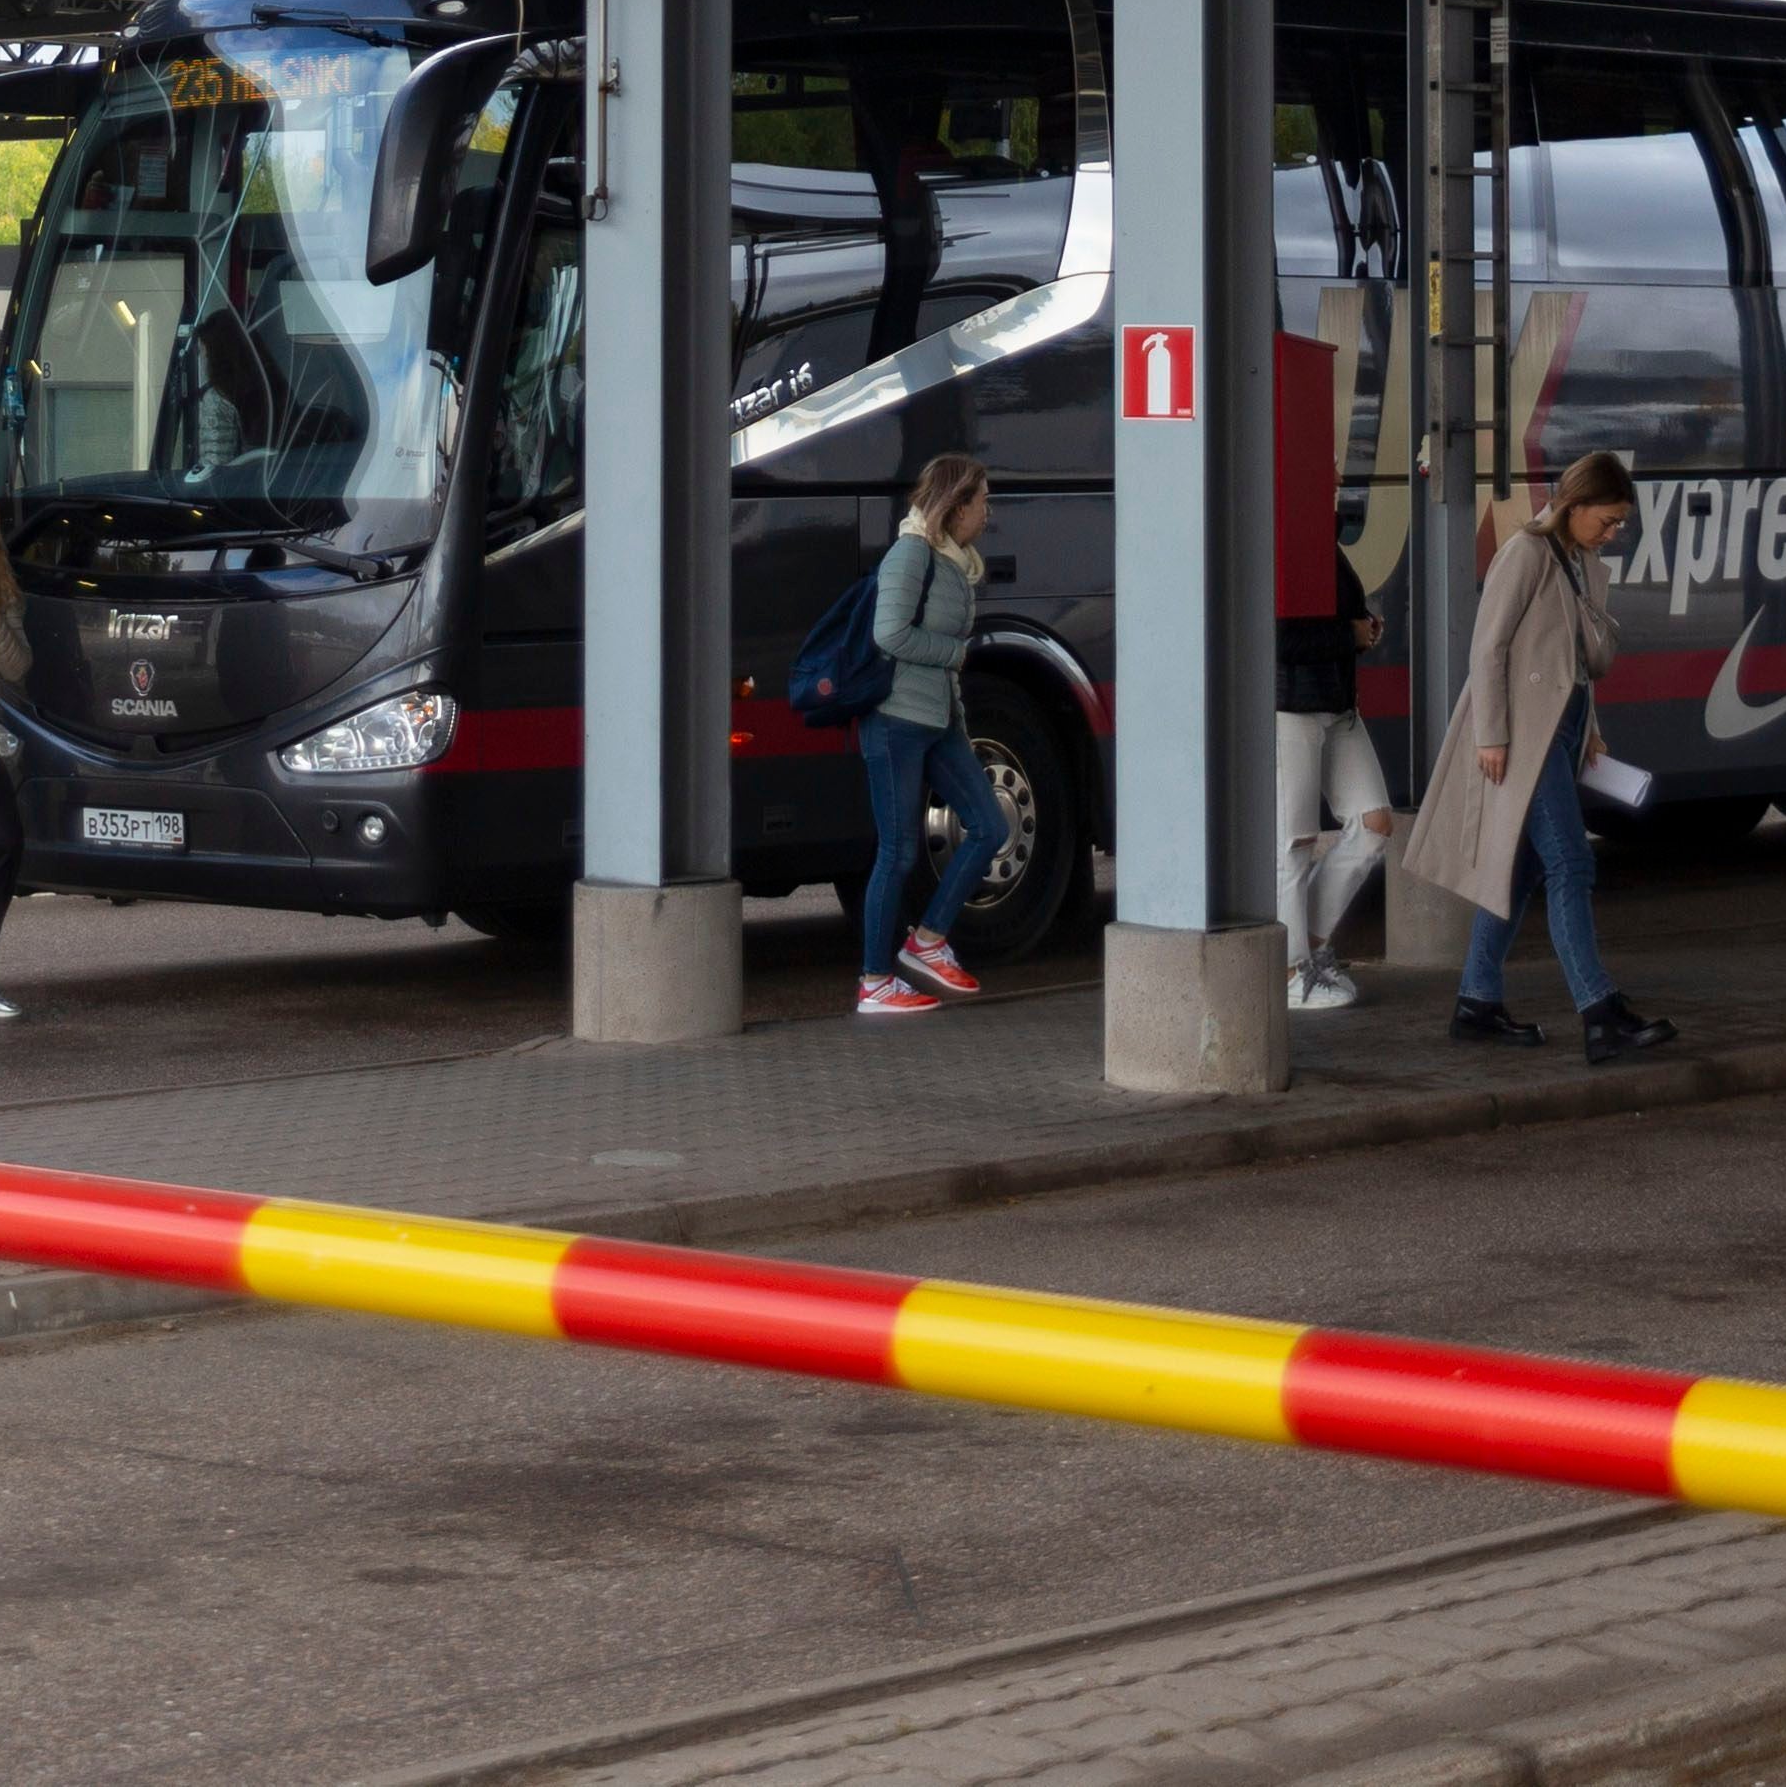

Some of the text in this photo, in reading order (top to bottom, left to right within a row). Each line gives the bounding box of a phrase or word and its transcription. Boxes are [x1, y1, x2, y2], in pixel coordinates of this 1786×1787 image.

[171, 54, 350, 110] 235 HELSINKI
[43, 362, 51, 379] B
[730, 380, 783, 423] izar
[108, 609, 179, 641] Irizar
[111, 699, 178, 717] SCANIA
[155, 815, 180, 834] 198
